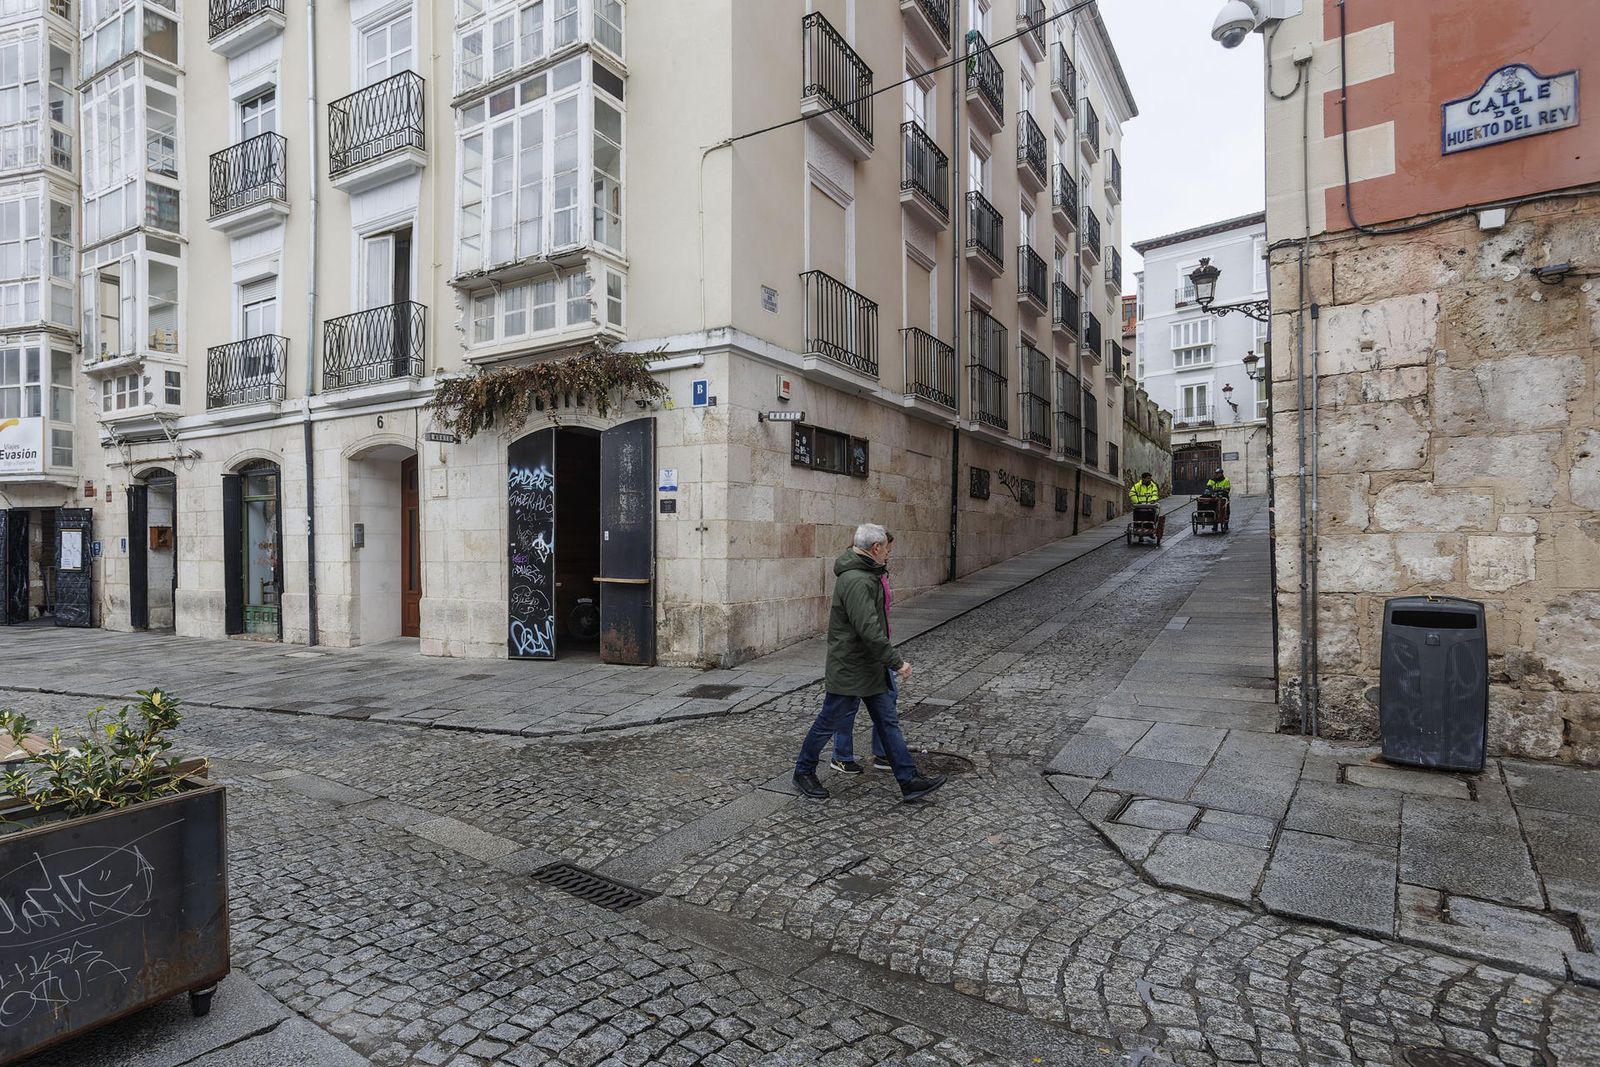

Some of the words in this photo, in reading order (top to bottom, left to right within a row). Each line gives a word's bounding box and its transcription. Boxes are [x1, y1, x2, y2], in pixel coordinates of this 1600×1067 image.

[1467, 81, 1551, 116] CALLE
[1447, 122, 1500, 147] HUERTO
[1503, 114, 1532, 134] DEL
[1538, 105, 1571, 126] REY
[697, 384, 703, 394] B
[376, 415, 384, 429] 6
[0, 448, 37, 460] Evasión
